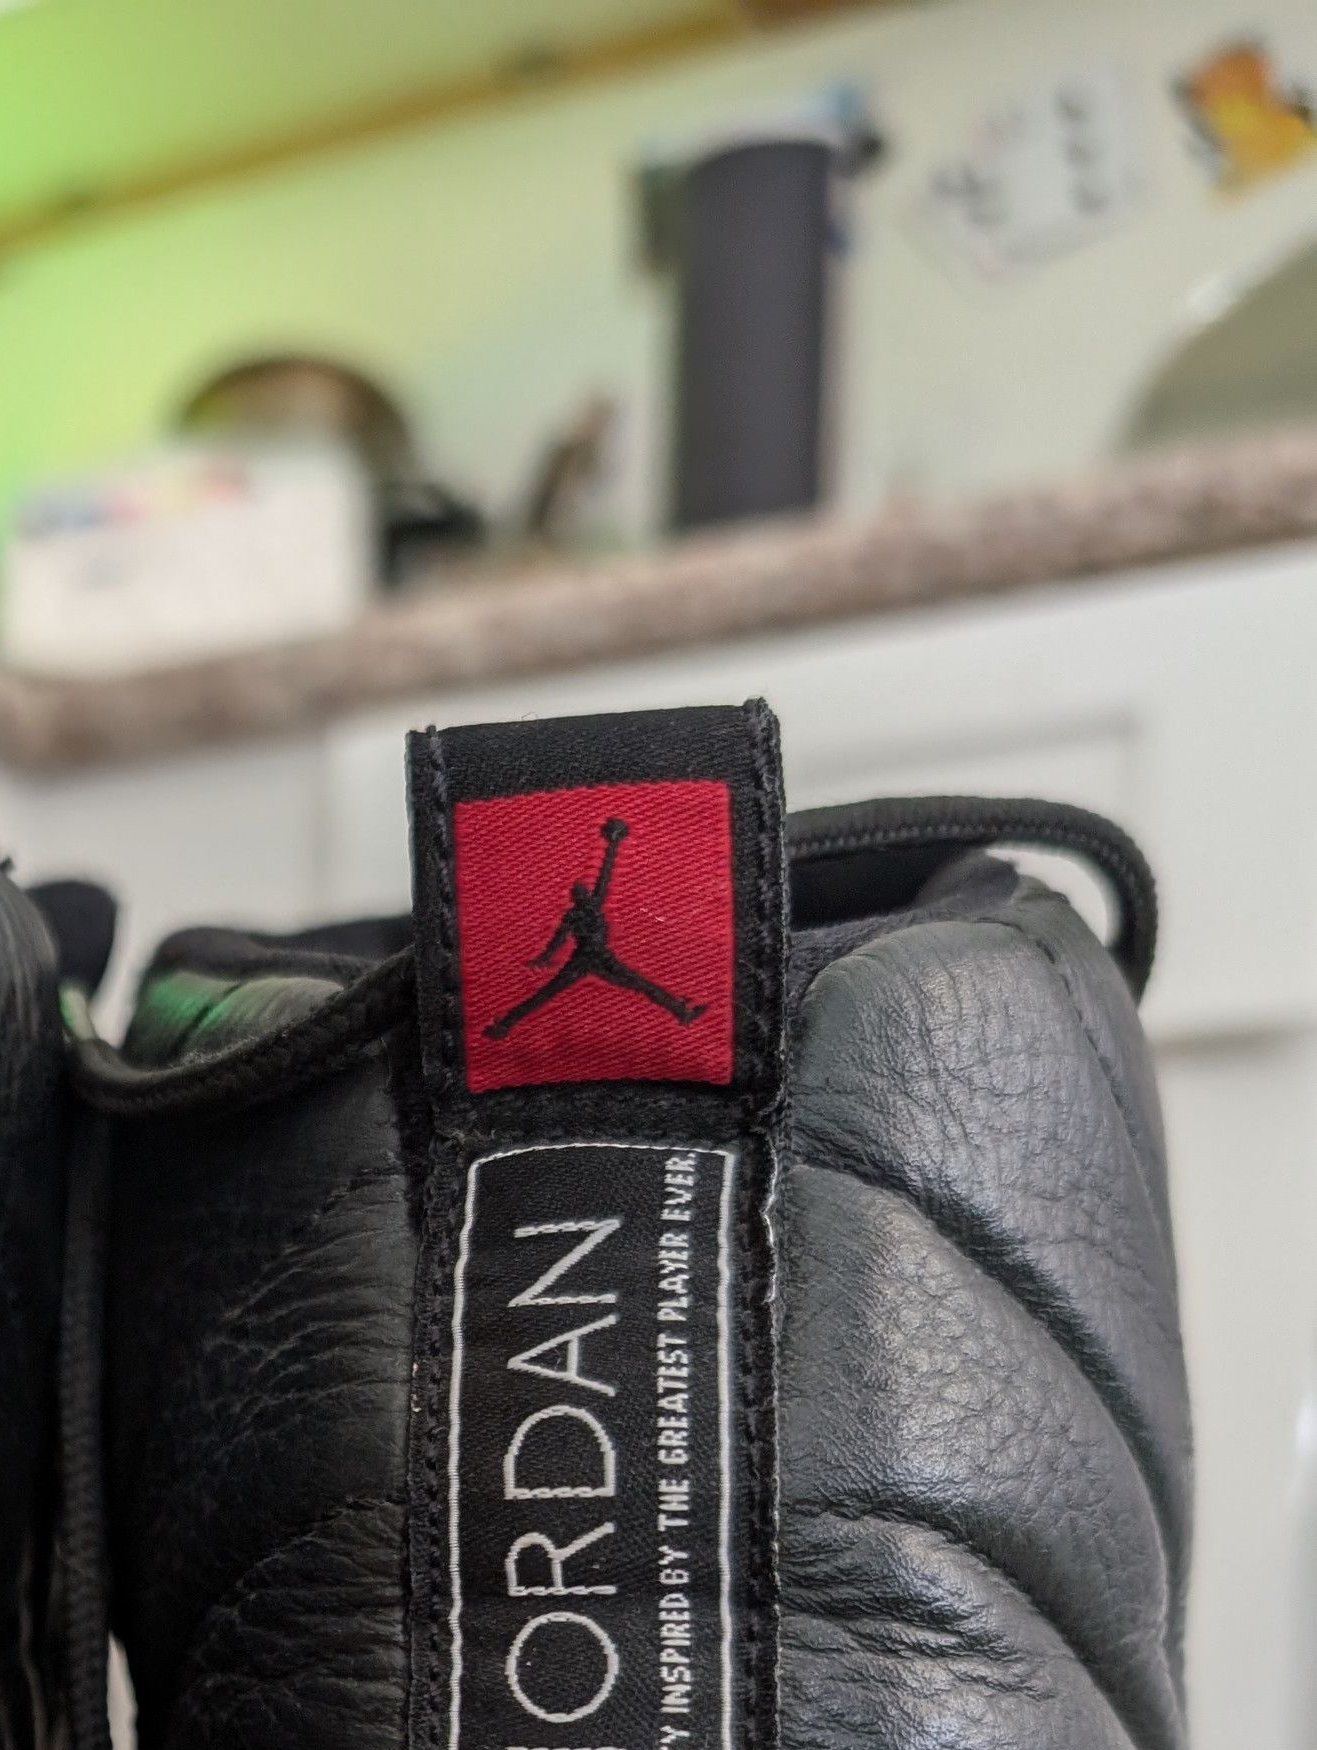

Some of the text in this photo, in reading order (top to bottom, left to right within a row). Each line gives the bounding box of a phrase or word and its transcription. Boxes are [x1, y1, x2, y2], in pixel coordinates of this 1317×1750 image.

[660, 1152, 697, 1221] EVER.
[657, 1231, 690, 1321] PLAYER
[657, 1333, 690, 1465] GREATEST
[657, 1479, 690, 1532] THE
[658, 1545, 691, 1585] BY
[658, 1592, 692, 1714] INSPIRED
